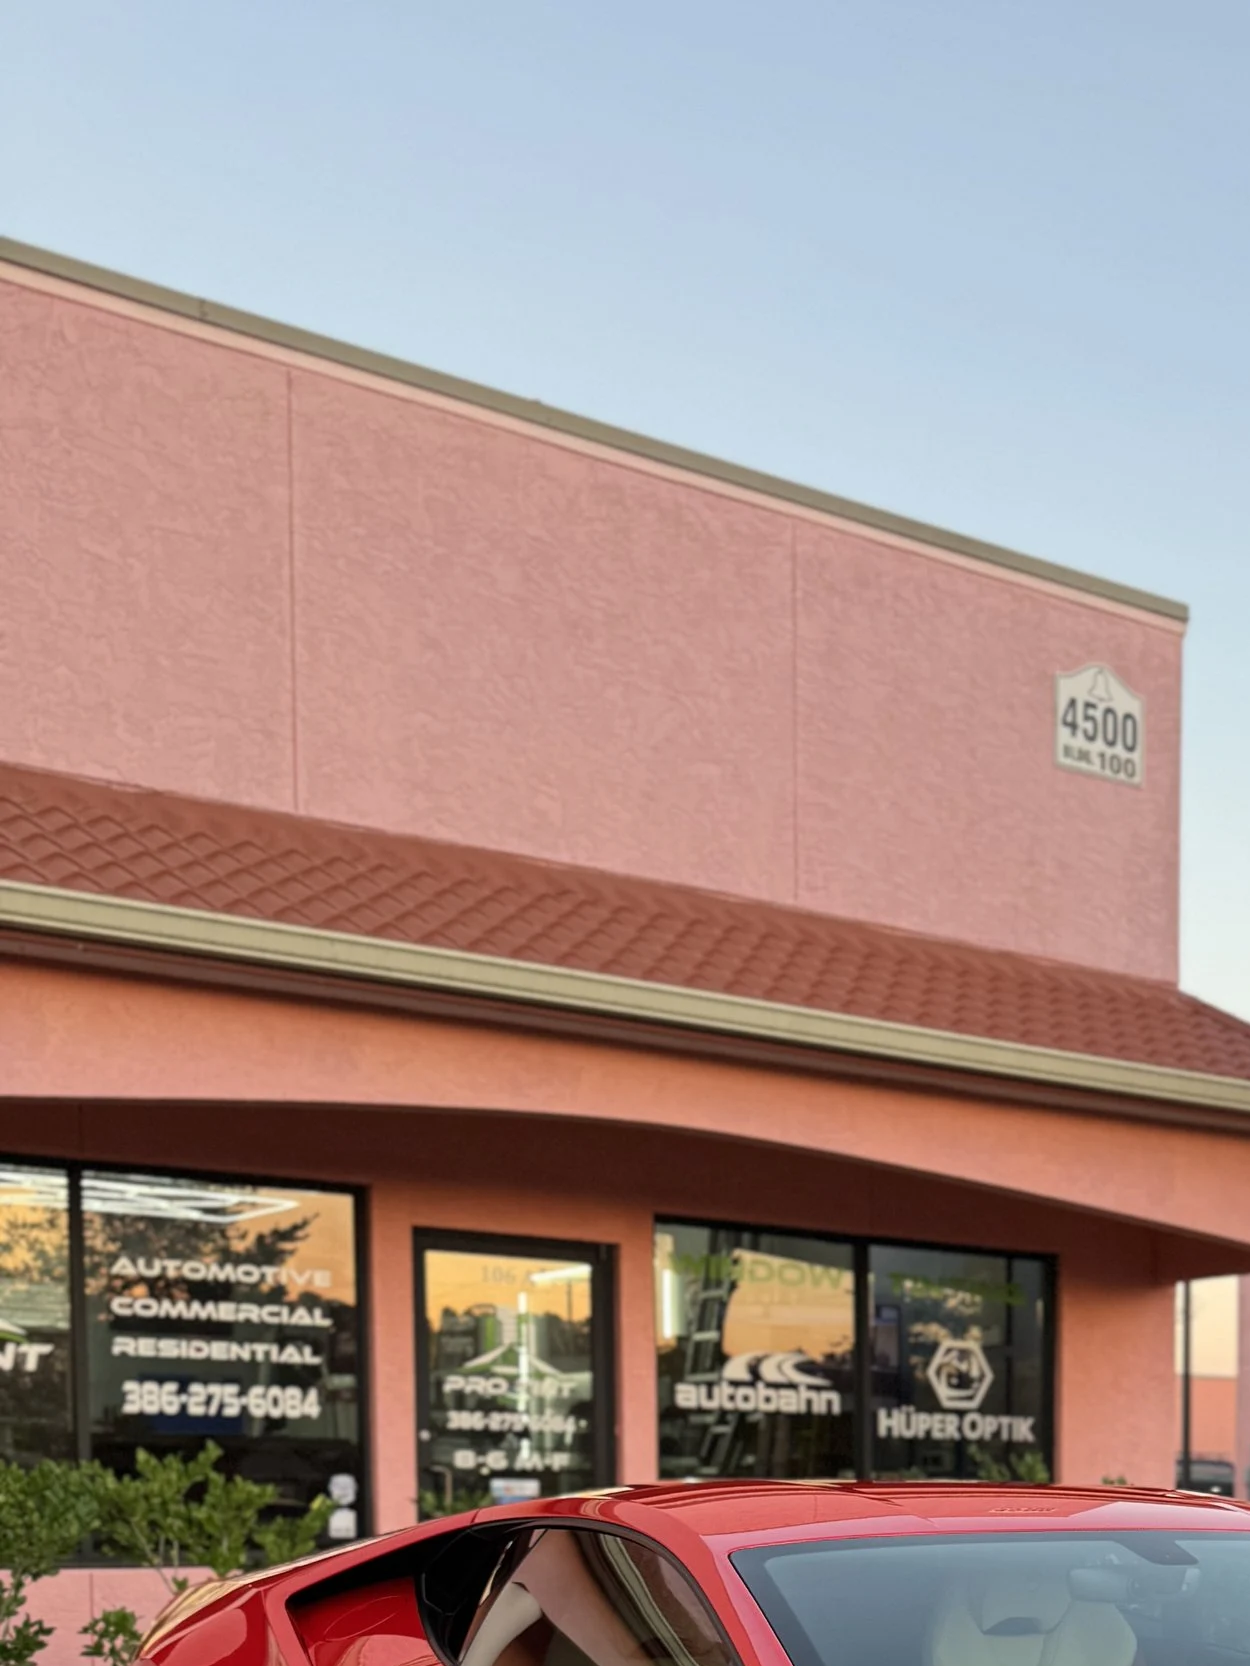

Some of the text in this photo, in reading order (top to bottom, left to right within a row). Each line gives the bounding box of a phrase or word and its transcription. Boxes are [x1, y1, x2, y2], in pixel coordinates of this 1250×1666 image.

[1062, 697, 1138, 753] 4500
[1098, 752, 1136, 778] 100
[110, 1255, 333, 1288] AUTOMOTIVE
[110, 1296, 333, 1327] COMMERCIAL
[111, 1336, 323, 1365] RESIDENTIAL
[121, 1379, 322, 1420] 386-275-6084
[443, 1375, 509, 1397] PRO
[674, 1381, 842, 1416] autobahn
[877, 1405, 1036, 1443] HÜPER OPTIK
